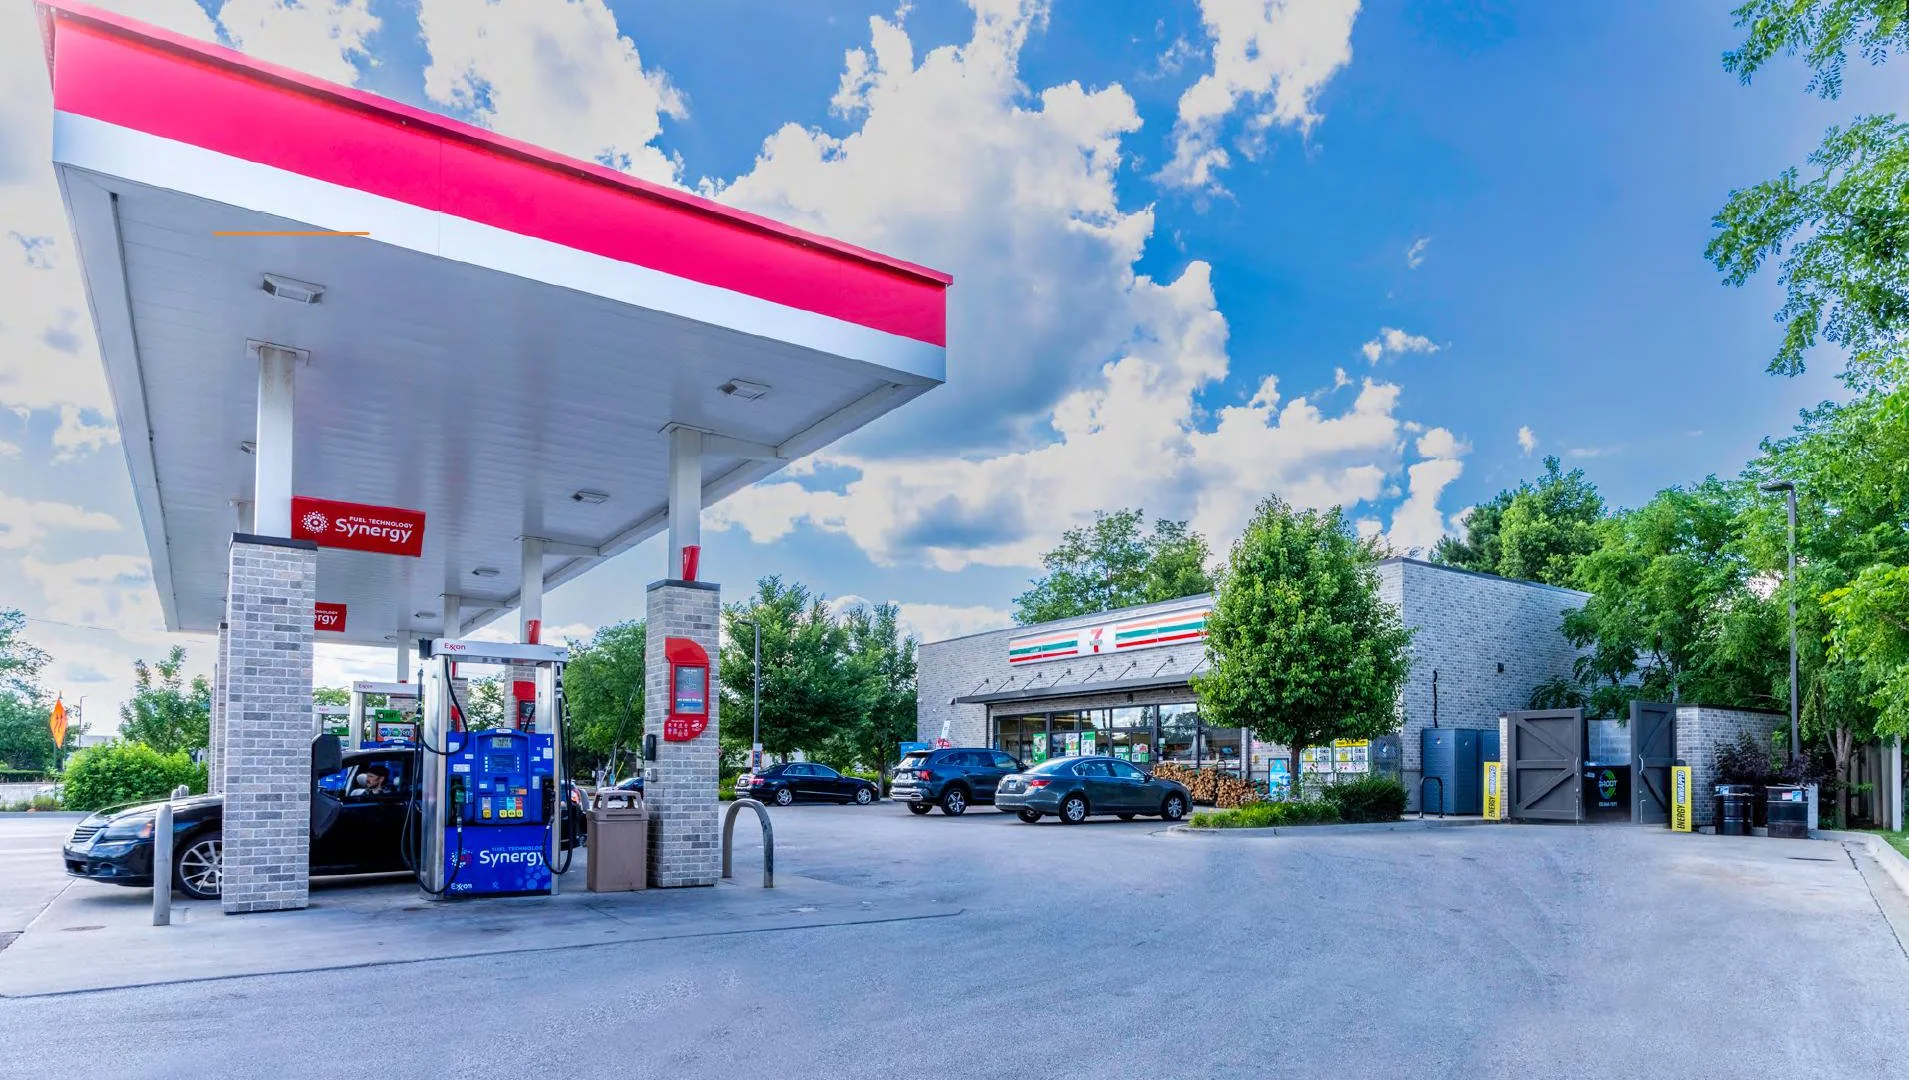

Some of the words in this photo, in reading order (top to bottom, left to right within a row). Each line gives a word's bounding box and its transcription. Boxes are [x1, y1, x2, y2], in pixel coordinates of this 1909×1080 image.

[349, 516, 367, 524] FUEL
[368, 518, 414, 529] TECHNOLOGY
[335, 518, 413, 544] Synergy
[444, 642, 466, 652] Exxon
[545, 737, 551, 747] 1
[1488, 796, 1496, 818] ENERGY
[1676, 804, 1686, 830] ENERGY
[479, 849, 544, 868] Synergy
[450, 882, 472, 891] Exxon
